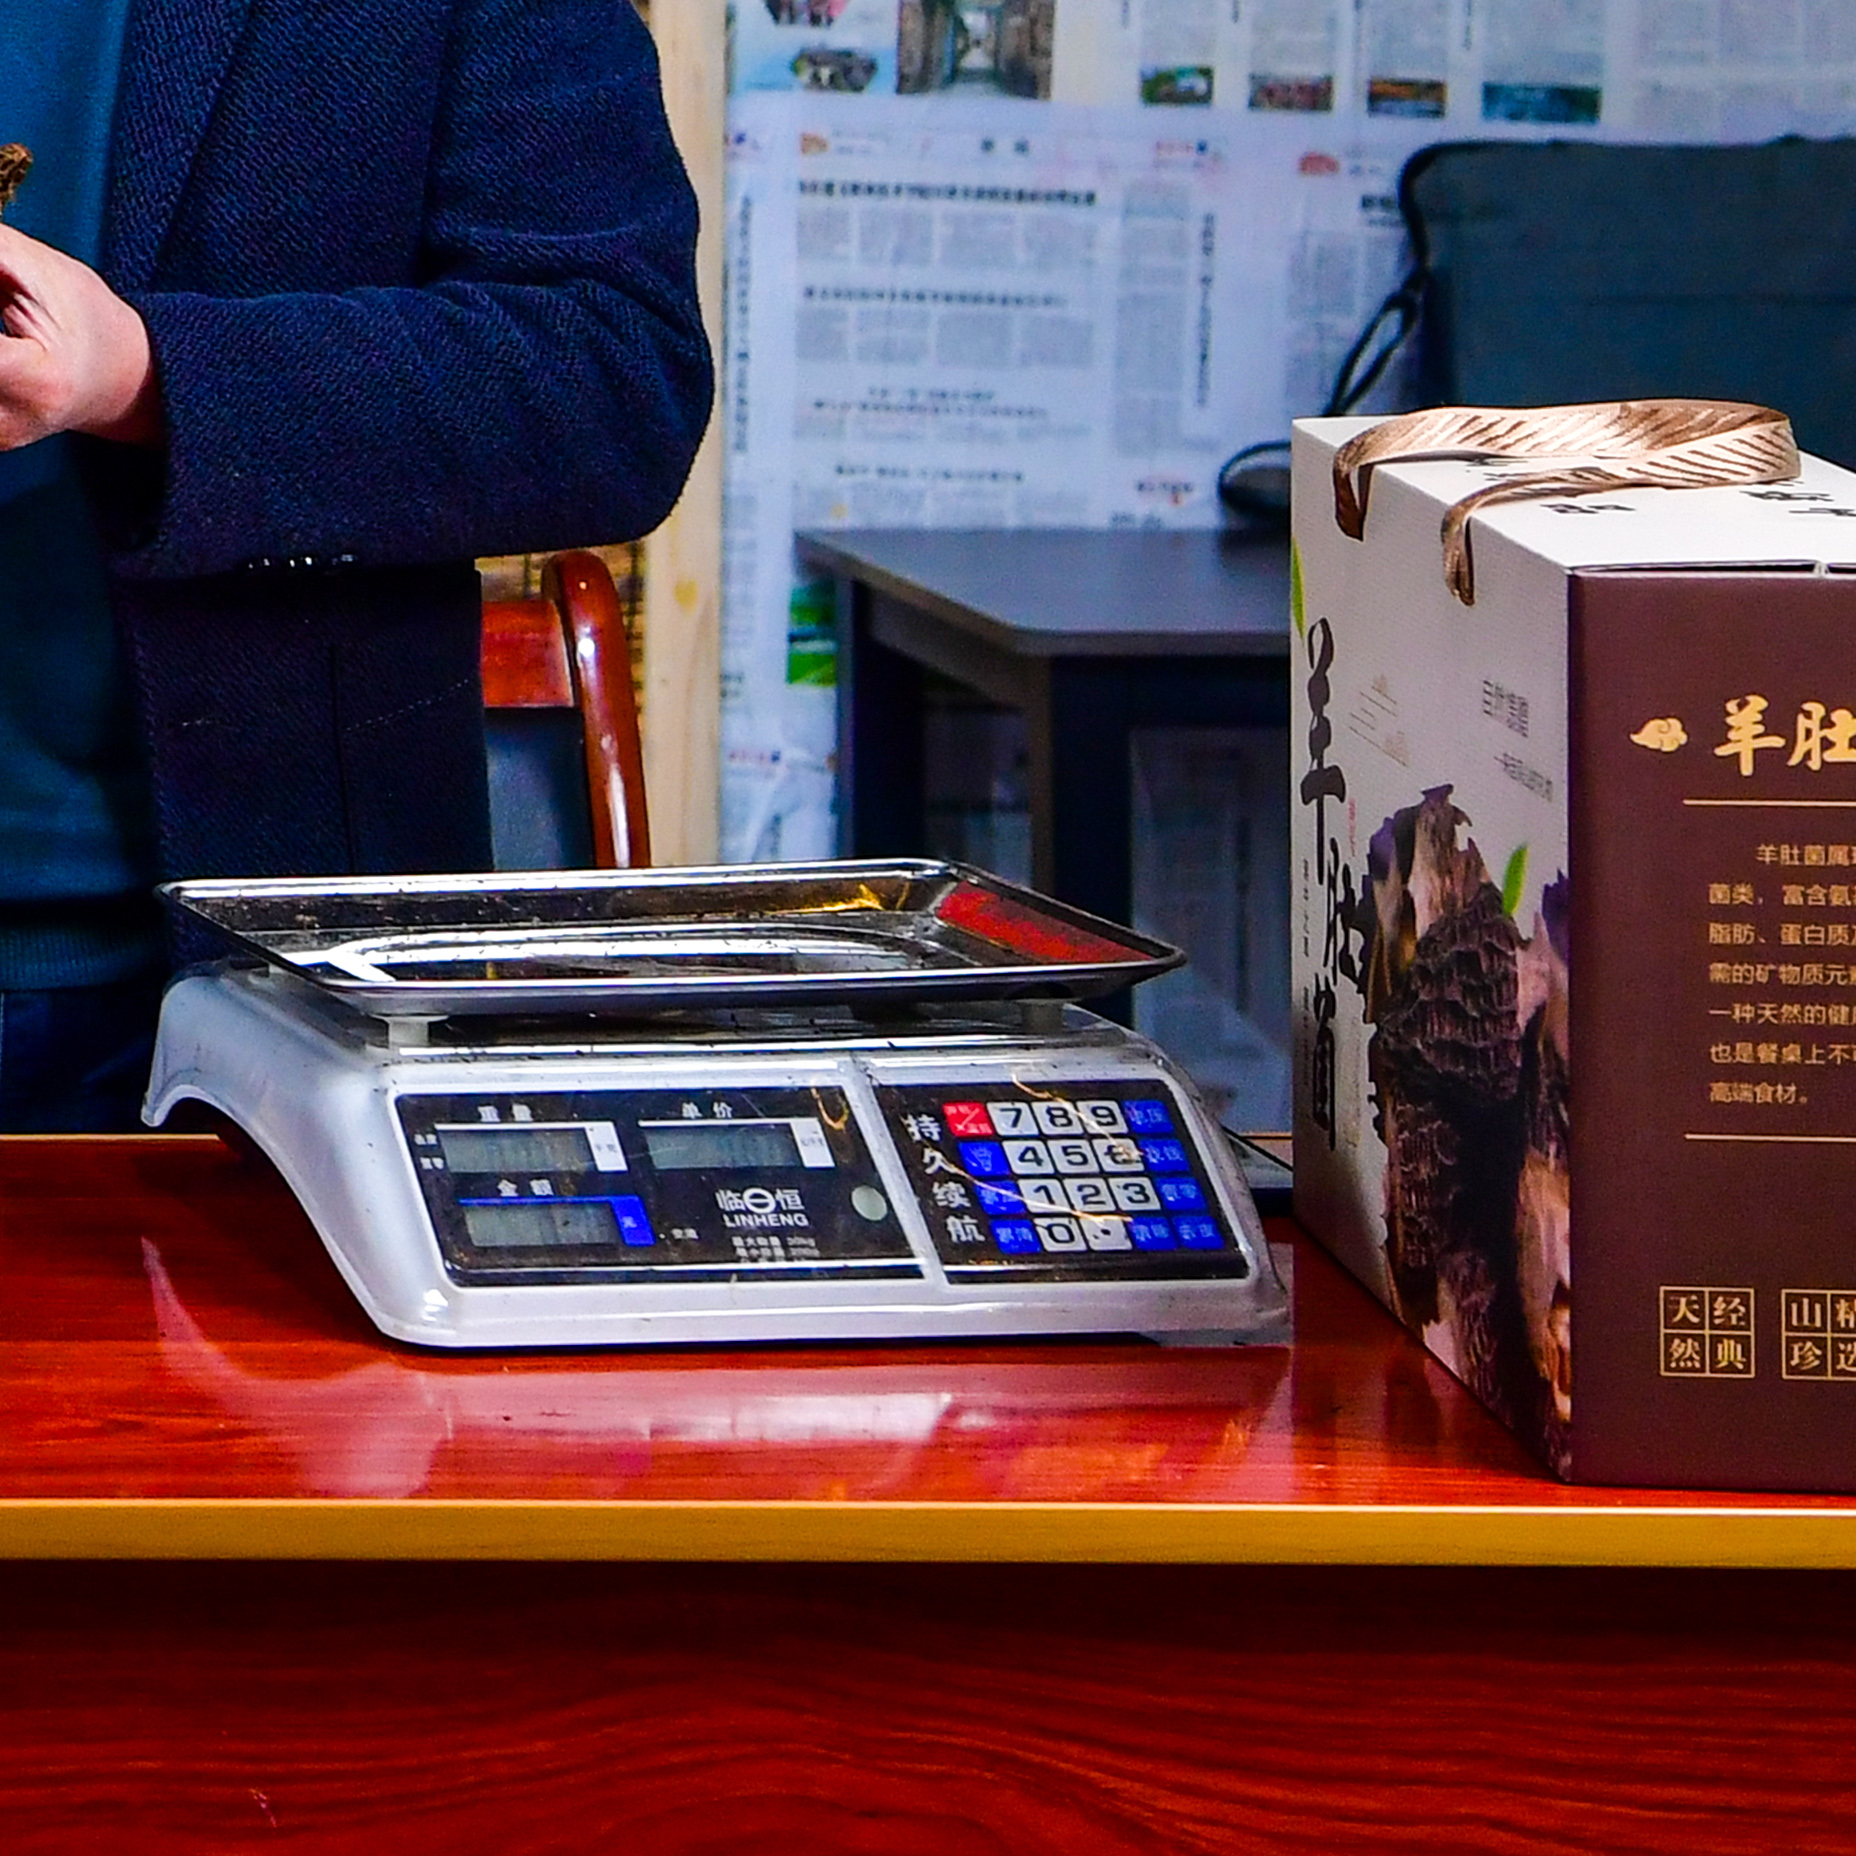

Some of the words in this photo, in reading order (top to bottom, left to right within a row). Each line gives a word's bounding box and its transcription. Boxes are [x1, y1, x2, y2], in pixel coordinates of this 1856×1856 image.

[1713, 693, 1856, 777] 羊肚
[1755, 844, 1856, 866] 羊肚菌属
[1708, 922, 1856, 946] 脂肪、蛋白质
[1708, 961, 1856, 985] 需的矿物质元
[1708, 1002, 1856, 1026] 一种天然的健
[1708, 1042, 1856, 1065] 也是餐桌上不
[681, 1101, 733, 1120] 单价
[999, 1107, 1024, 1129] 7
[1047, 1106, 1073, 1128] 8
[1090, 1105, 1118, 1127] 9
[1018, 1145, 1044, 1167] 4
[1062, 1145, 1089, 1166] 5
[902, 1112, 986, 1244] 持久续航
[1076, 1184, 1108, 1204] 2
[1122, 1182, 1151, 1204] 3
[722, 1213, 809, 1229] LINHENG
[1046, 1223, 1076, 1244] 0
